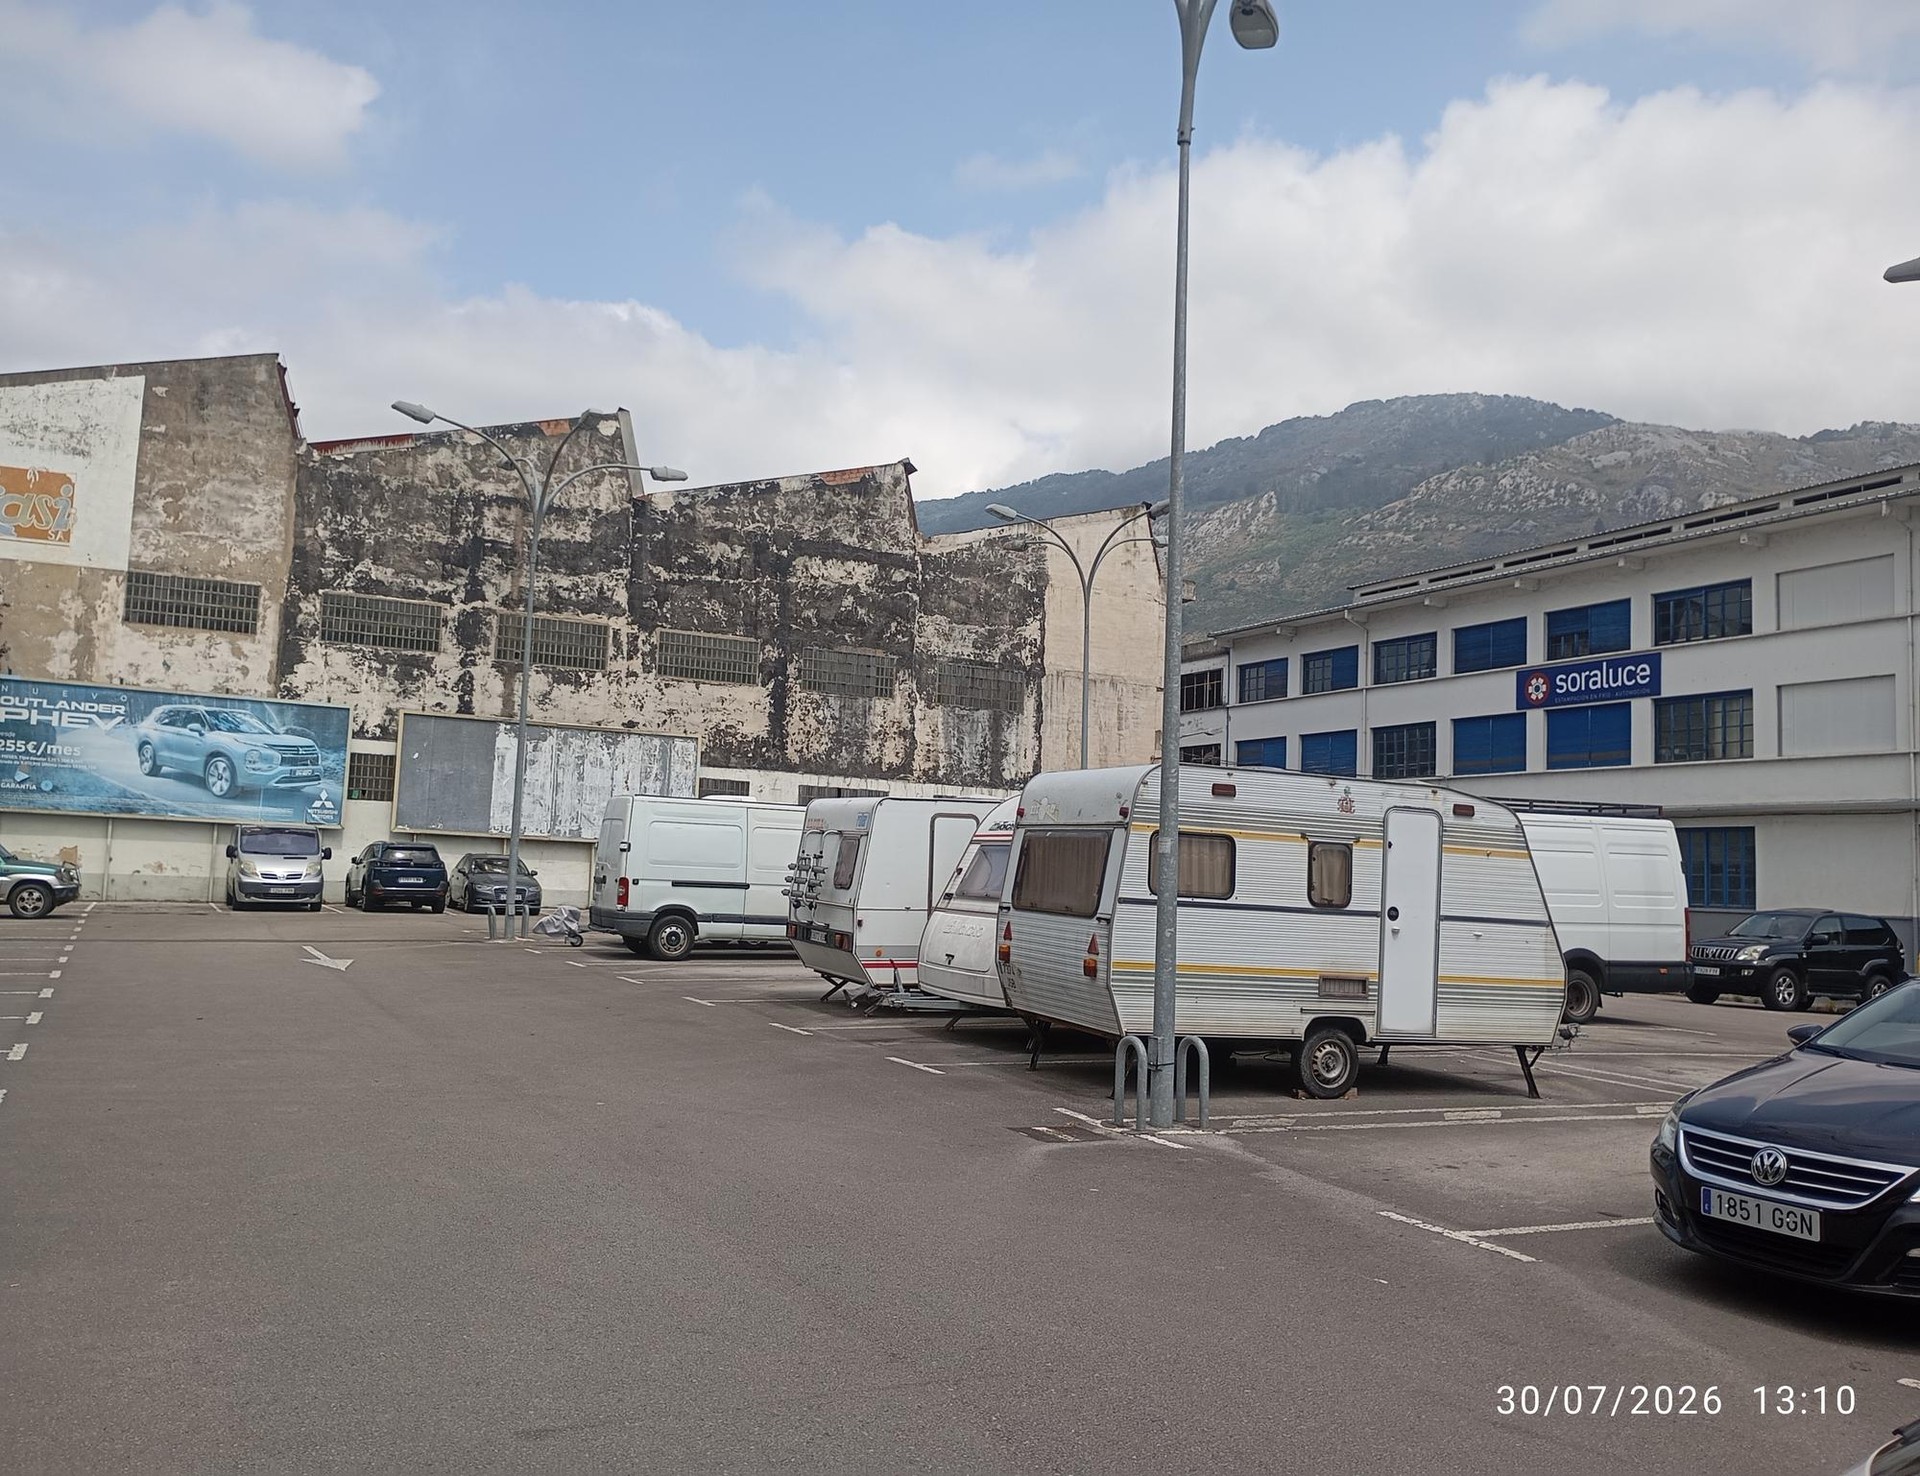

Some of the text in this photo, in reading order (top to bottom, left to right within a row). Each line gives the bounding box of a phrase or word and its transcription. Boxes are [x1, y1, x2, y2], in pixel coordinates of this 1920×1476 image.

[1555, 661, 1650, 693] soraluce
[0, 695, 126, 715] OUTLANDER
[1, 684, 127, 702] NUEVO
[0, 706, 126, 731] PHEV
[1716, 1194, 1813, 1237] 1851 GGN
